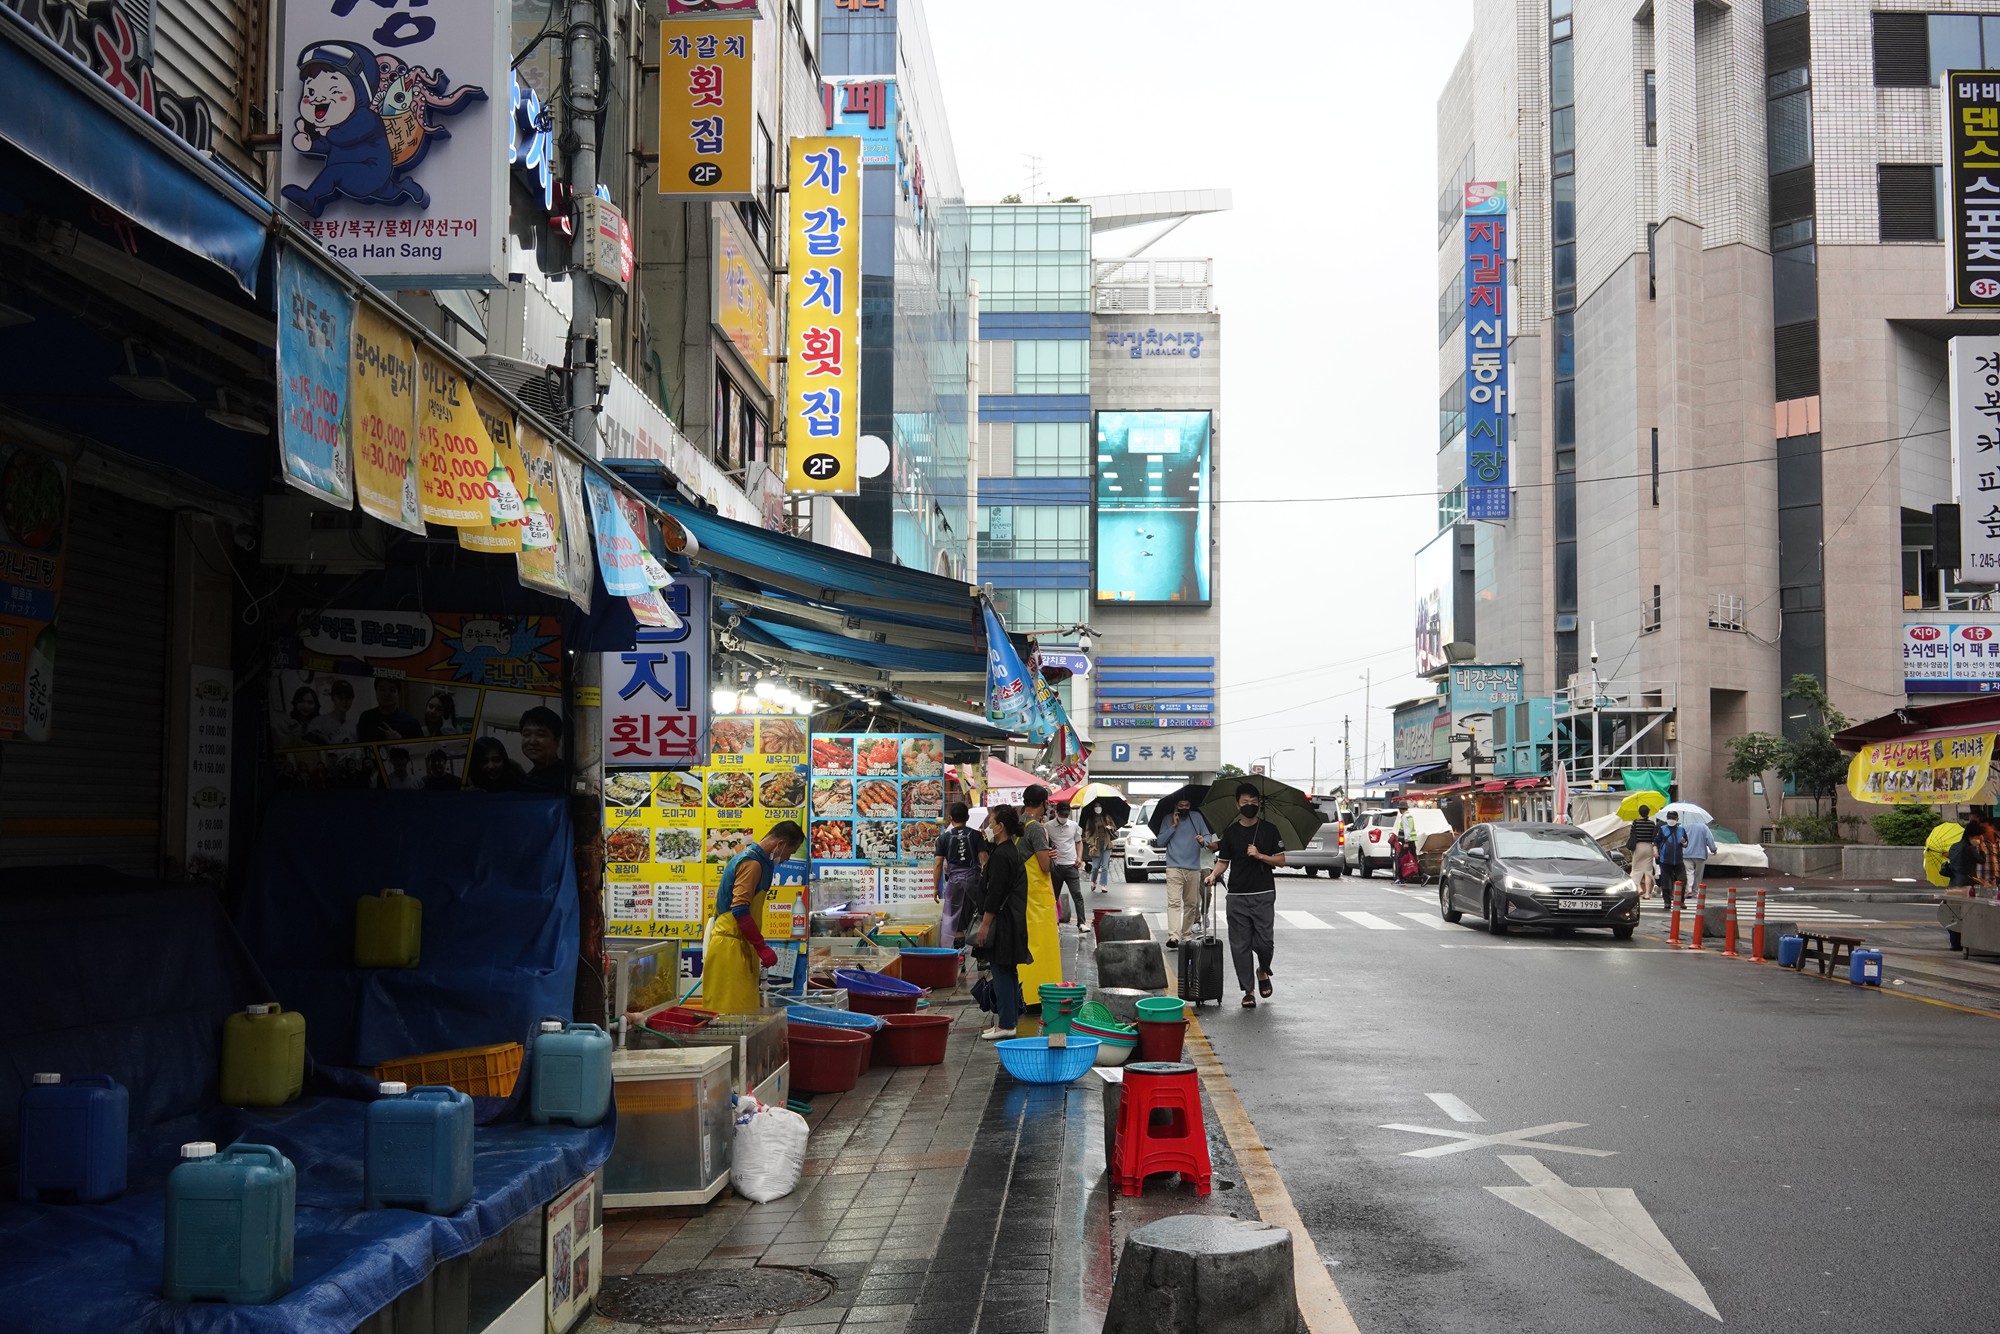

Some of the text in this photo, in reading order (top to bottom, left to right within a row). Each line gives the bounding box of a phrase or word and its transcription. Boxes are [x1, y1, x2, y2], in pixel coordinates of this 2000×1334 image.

[669, 34, 745, 60] 자갈치
[688, 64, 725, 155] 횟집
[1962, 107, 1999, 169] 댄스
[695, 166, 717, 182] 2F
[1964, 176, 2000, 272] 스포츠
[327, 243, 442, 261] Sea Han Sang
[801, 146, 847, 437] 자갈치횟집
[1975, 281, 1998, 296] 3F
[1107, 328, 1204, 359] 자갈치시장
[422, 361, 461, 407] 아나고
[809, 458, 834, 475] 2F
[1914, 628, 1937, 639] 지하
[1968, 628, 1986, 640] 1층
[1042, 655, 1085, 669] 갈치로 46
[1456, 669, 1520, 691] 대강수산
[610, 715, 697, 757] 횟집
[765, 755, 800, 765] 새우구이
[1115, 745, 1126, 760] P
[1138, 745, 1198, 761] 주차장
[1881, 739, 1931, 767] 부산어묵
[614, 808, 642, 819] 전복회
[662, 808, 697, 819] 도미구이
[717, 809, 743, 819] 해물탕
[764, 809, 799, 819] 간장게장
[670, 864, 686, 874] 낙지
[1580, 901, 1599, 909] 1998
[648, 922, 679, 937] 부산의
